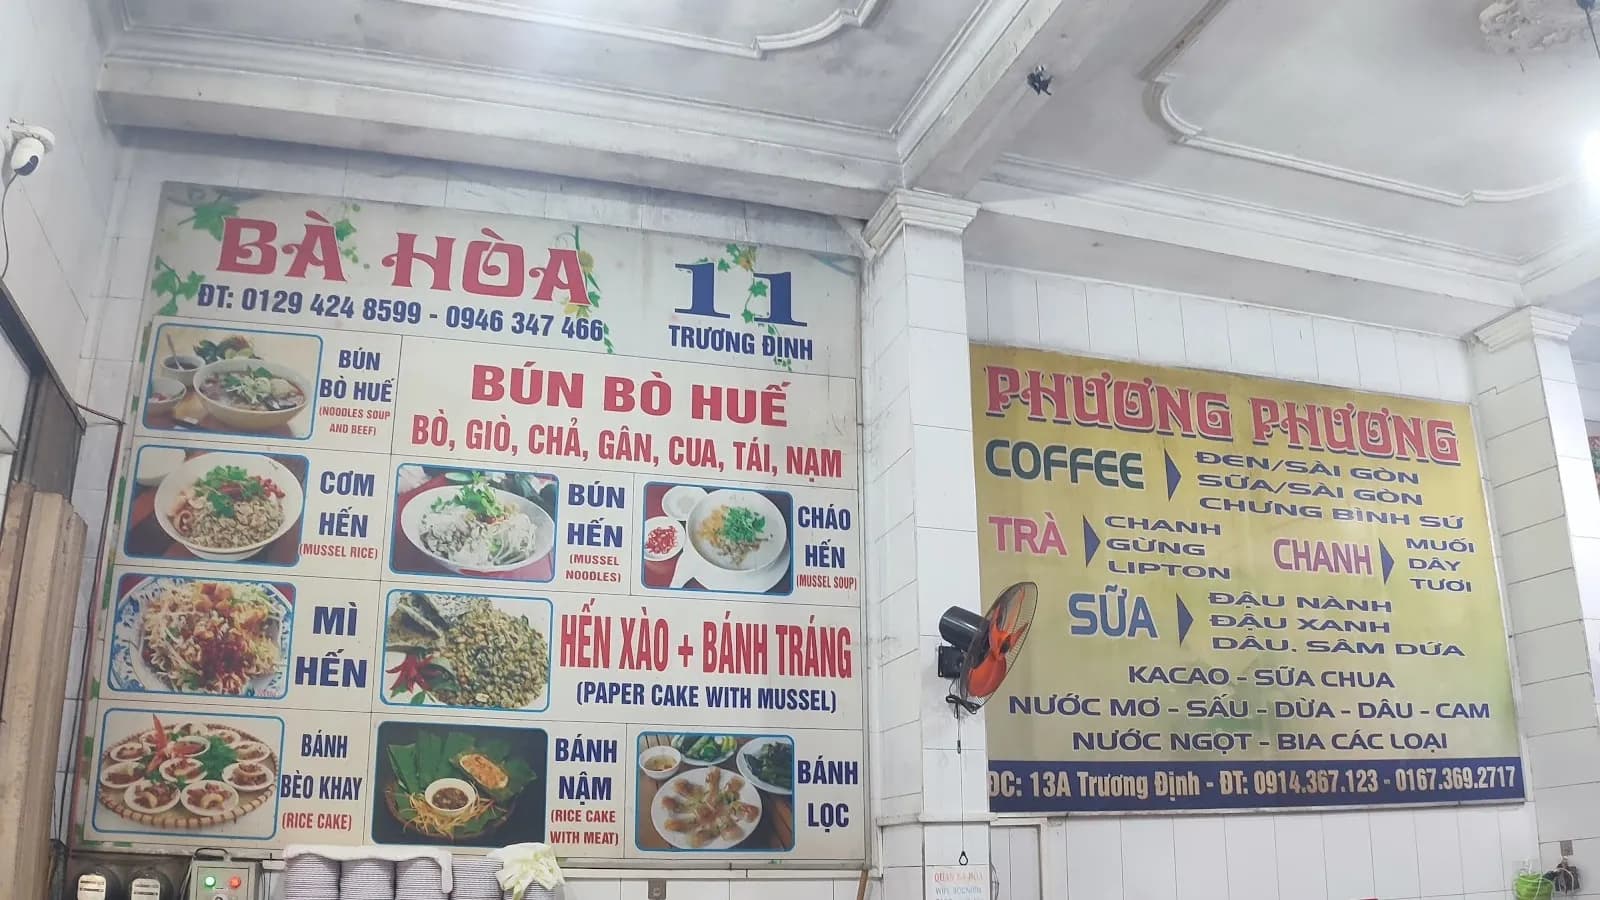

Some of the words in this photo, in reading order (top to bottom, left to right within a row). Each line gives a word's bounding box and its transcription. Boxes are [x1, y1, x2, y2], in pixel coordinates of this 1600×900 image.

[217, 210, 347, 282] BÀ
[381, 227, 592, 306] HÒA
[197, 283, 234, 309] ĐT:
[241, 287, 303, 314] 0129
[310, 294, 355, 319] 424
[362, 298, 421, 325] 8599
[446, 306, 503, 332] 0946
[511, 312, 553, 336] 347
[561, 317, 604, 341] 466
[669, 325, 755, 355] TRƯƠNG
[762, 335, 813, 361] ĐỊNH
[339, 347, 380, 371] BÚN
[320, 375, 347, 399] BÒ
[353, 377, 395, 402] HUẾ
[472, 361, 584, 409] BÚN
[603, 371, 672, 417] BÒ
[691, 381, 791, 428] HUẾ
[319, 406, 364, 419] (NOODLES
[367, 409, 391, 420] SOUP
[984, 366, 1233, 443] PHƯƠNG
[1249, 396, 1461, 466] PHƯƠNG
[329, 423, 348, 434] AND
[351, 425, 377, 436] BEEF)
[411, 408, 455, 452] BÒ,
[466, 414, 518, 457] GIÒ,
[528, 417, 588, 462] CHẢ,
[600, 426, 659, 468] GÂN,
[669, 435, 724, 473] CUA,
[733, 437, 778, 475] TÁI,
[786, 446, 842, 482] NẠM
[986, 439, 1145, 489] COFFEE
[1195, 451, 1340, 478] ĐEN/SÀI
[1351, 463, 1419, 485] GÒN
[319, 470, 375, 497] CƠM
[568, 480, 625, 509] BÚN
[1197, 473, 1344, 499] SỮA/SÀI
[1353, 487, 1423, 506] GÒN
[318, 506, 369, 538] HẾN
[798, 503, 851, 531] CHÁO
[1104, 516, 1221, 536] CHANH
[1332, 507, 1410, 525] BÌNH
[1419, 515, 1463, 530] SỨ
[567, 517, 623, 548] HẾN
[988, 512, 1067, 556] TRÀ
[1106, 537, 1206, 556] GỪNG
[1406, 537, 1475, 553] MUỐI
[299, 544, 346, 558] (MUSSEL
[350, 546, 378, 560] RICE)
[569, 553, 620, 566] (MUSSEL
[805, 539, 845, 569] HẾN
[1273, 539, 1373, 576] CHANH
[1408, 557, 1461, 572] DÂY
[566, 570, 621, 583] NOODLES)
[796, 574, 831, 589] (MUSSEL
[834, 576, 857, 591] SOUP)
[1108, 561, 1230, 580] LIPTON
[1410, 578, 1472, 593] TƯƠI
[1068, 584, 1158, 638] SỮA
[1208, 591, 1285, 609] ĐẬU
[1297, 595, 1392, 613] NÀNH
[312, 601, 358, 636] MÌ
[1210, 613, 1287, 631] ĐẬU
[1297, 618, 1390, 633] XANH
[560, 597, 611, 669] HẾN
[618, 606, 669, 672] XÀO
[678, 634, 694, 668] +
[703, 610, 768, 675] BÁNH
[776, 614, 853, 679] TRÁNG
[1306, 639, 1384, 655] SÂM
[1395, 641, 1465, 657] DỨA
[295, 648, 367, 688] HẾN
[1129, 666, 1230, 685] KACAO
[1254, 666, 1315, 686] SỮA
[1321, 671, 1395, 688] CHUA
[576, 681, 645, 705] (PAPER
[651, 684, 699, 707] CAKE
[706, 686, 751, 709] WITH
[758, 687, 836, 713] MUSSEL)
[1009, 692, 1101, 716] NƯỚC
[1110, 697, 1160, 717] MƠ
[1187, 694, 1248, 717] SẤU
[1275, 698, 1335, 718] DỪA
[1358, 699, 1413, 719] DÂU
[1436, 703, 1490, 719] CAM
[301, 729, 348, 759] BÁNH
[555, 733, 617, 764] BÁNH
[1073, 728, 1161, 750] NƯỚC
[1171, 733, 1252, 754] NGỌT
[1278, 734, 1325, 750] BIA
[1331, 729, 1384, 750] CÁC
[1390, 733, 1447, 753] LOẠI
[798, 755, 858, 785] BÁNH
[987, 771, 1022, 797] ĐC:
[1030, 771, 1071, 797] 13A
[1076, 772, 1148, 799] Trương
[1154, 771, 1200, 801] Định
[1219, 770, 1248, 795] ĐT:
[1254, 769, 1378, 794] 0914.367.123
[1395, 766, 1515, 791] 0167.369.2717
[281, 770, 315, 799] BÈO
[319, 776, 362, 801] KHAY
[558, 771, 612, 806] NẬM
[282, 812, 315, 830] (RICE
[317, 813, 353, 831] CAKE)
[551, 808, 583, 824] (RICE
[585, 809, 616, 823] CAKE
[808, 803, 849, 833] LỌC
[550, 830, 581, 845] WITH
[583, 830, 619, 846] MEAT)
